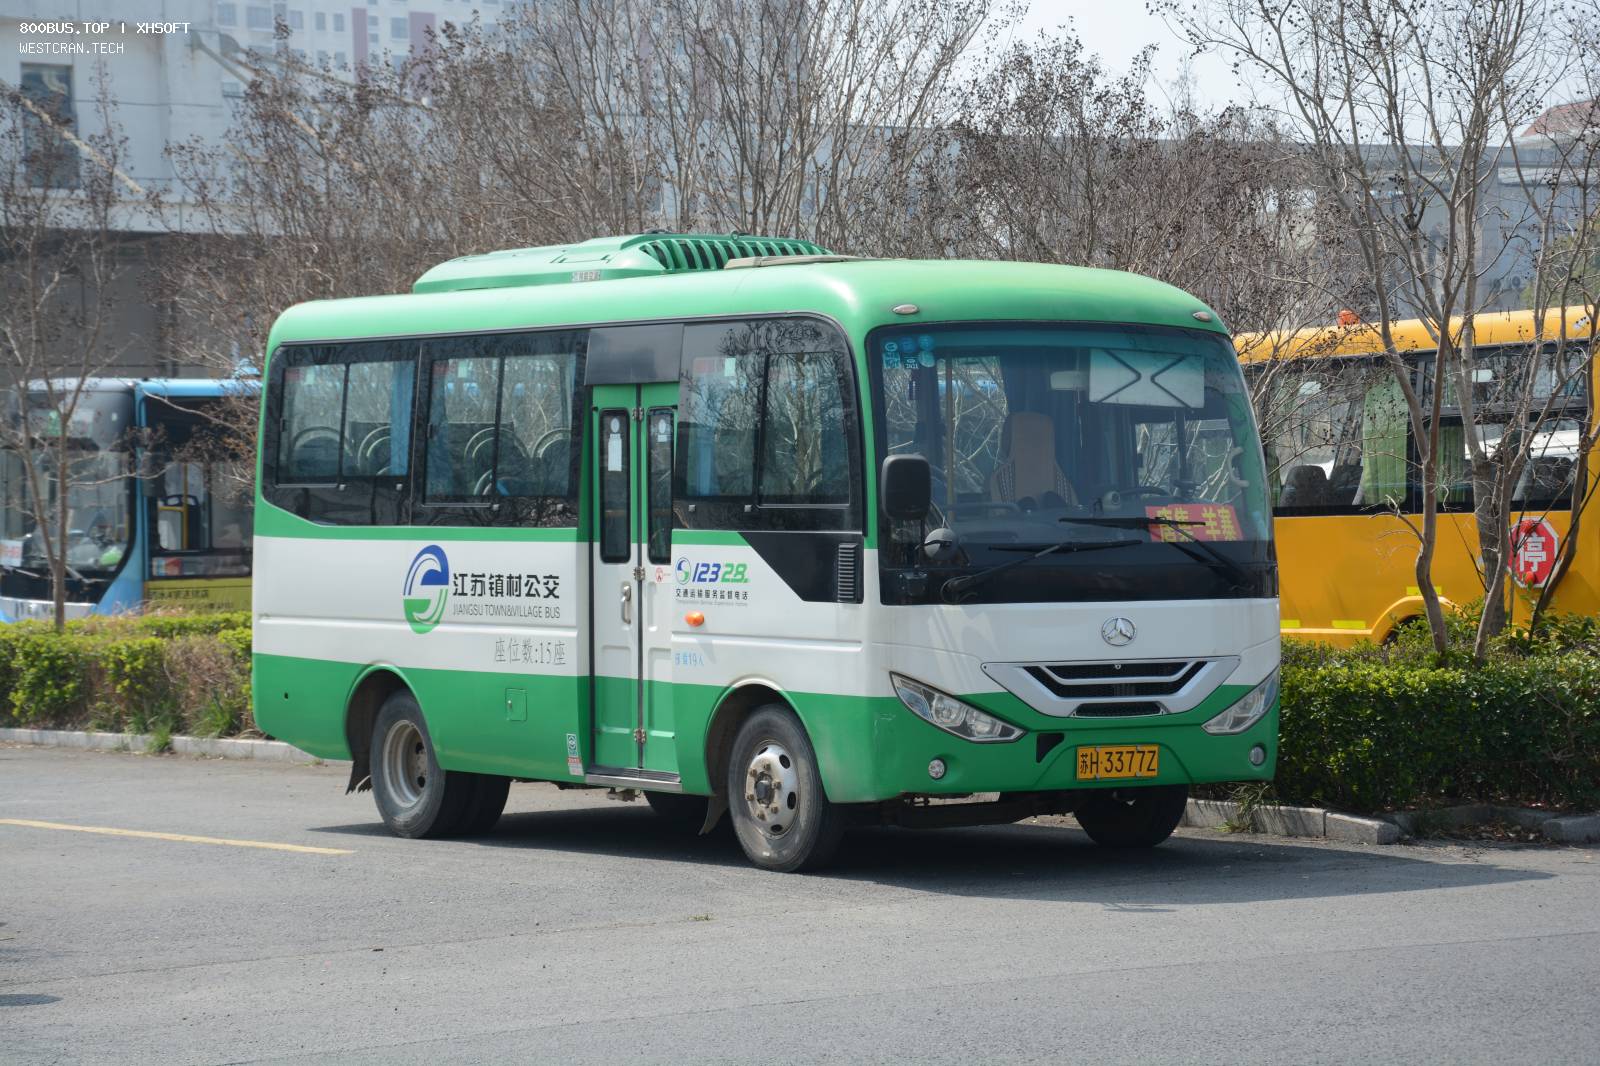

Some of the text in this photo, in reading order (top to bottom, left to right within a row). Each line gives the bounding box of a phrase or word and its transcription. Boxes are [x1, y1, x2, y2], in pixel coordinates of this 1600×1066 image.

[1517, 531, 1546, 572] 停
[452, 572, 560, 600] 江苏镇村公交
[452, 603, 561, 619] JIANGSU TOWN&VILLAGE BUS
